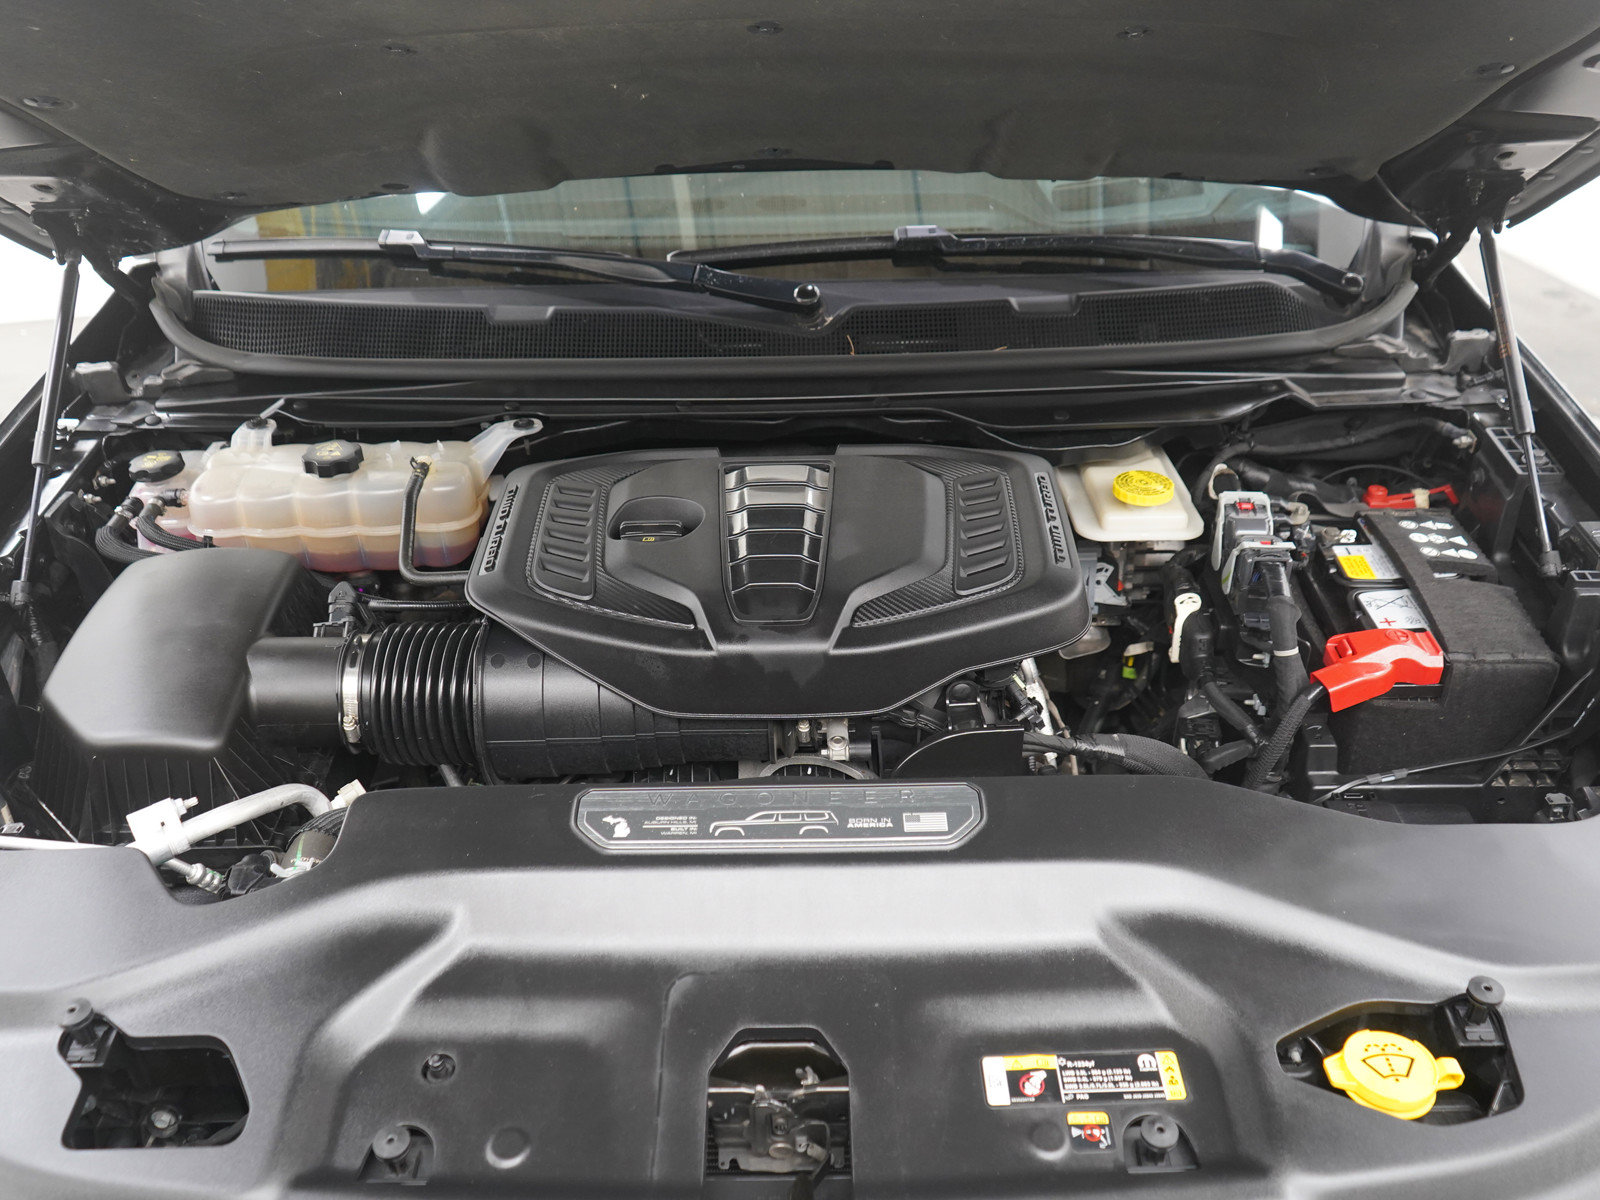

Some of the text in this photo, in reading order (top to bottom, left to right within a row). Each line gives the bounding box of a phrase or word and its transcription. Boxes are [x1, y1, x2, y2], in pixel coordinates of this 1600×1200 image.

[483, 484, 519, 573] TWIN TURBO
[1037, 475, 1066, 565] TWIN TURBO
[648, 789, 915, 806] WAGONEER
